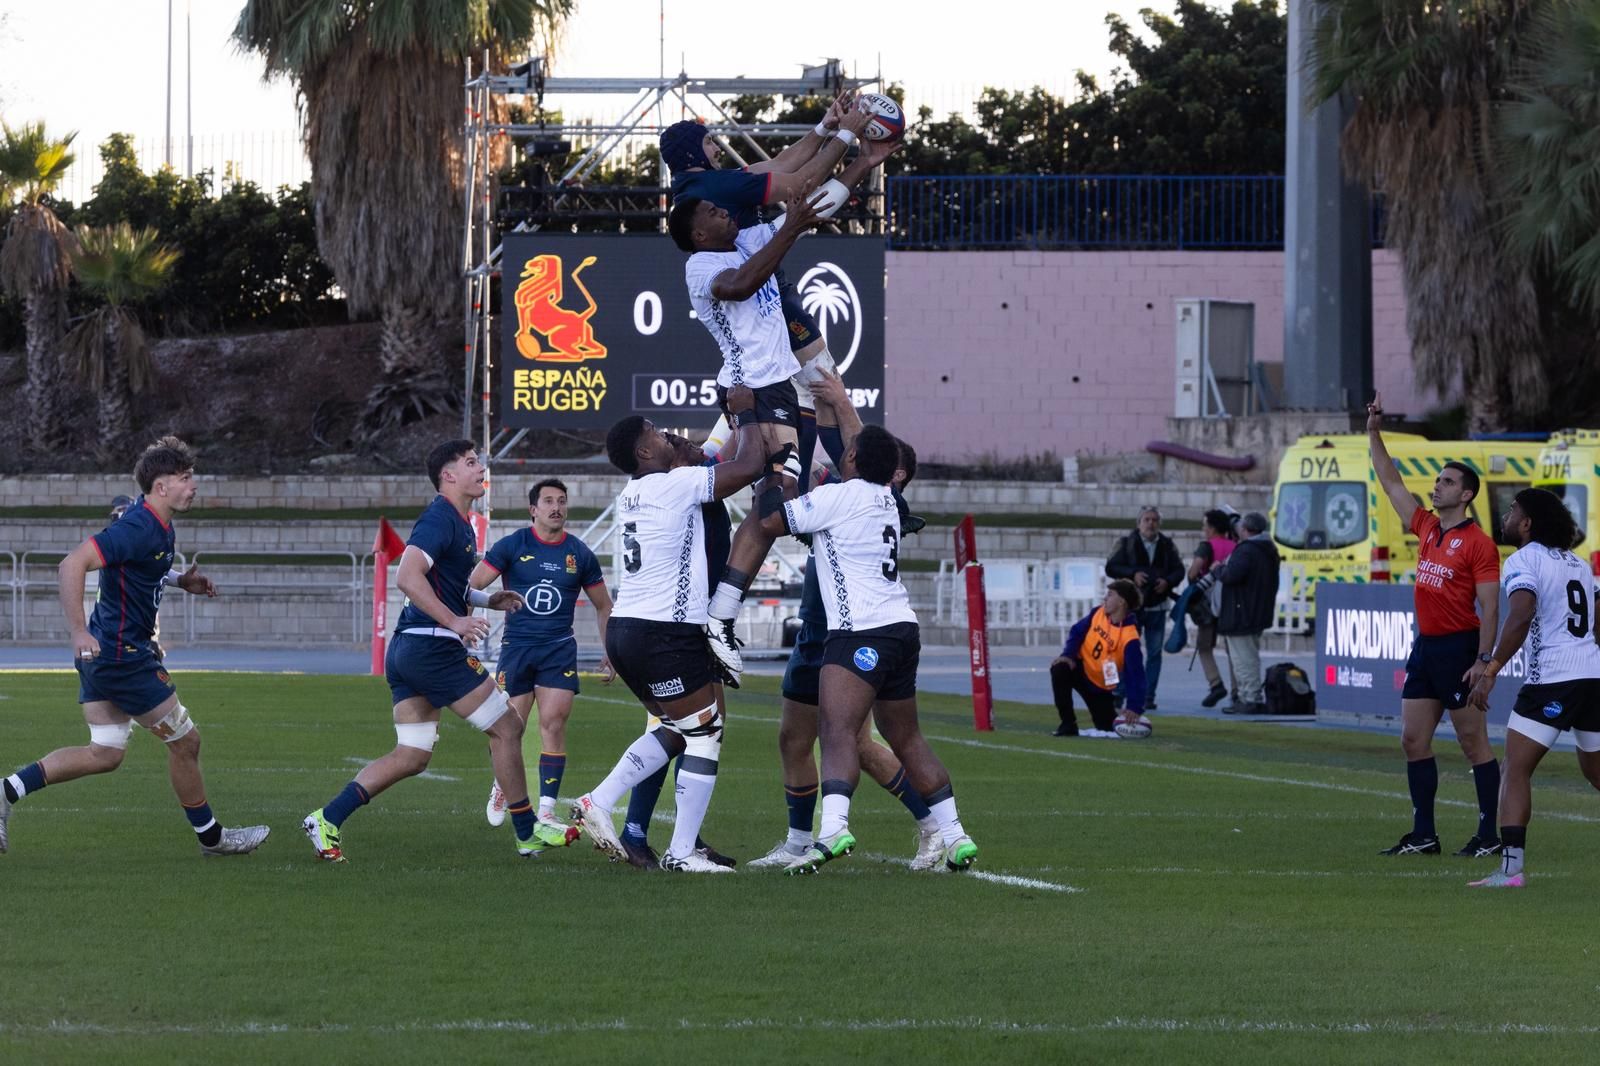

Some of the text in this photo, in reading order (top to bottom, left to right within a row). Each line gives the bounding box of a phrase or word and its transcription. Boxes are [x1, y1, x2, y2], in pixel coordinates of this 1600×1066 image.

[633, 291, 663, 335] 0
[514, 367, 607, 388] ESPAÑA
[514, 389, 607, 411] RUGBY
[651, 379, 718, 406] 00:5
[1300, 456, 1341, 478] DYA
[1542, 454, 1571, 479] DYA
[622, 521, 642, 574] 5
[882, 525, 898, 582] 3
[1566, 579, 1589, 639] 9
[1325, 608, 1414, 661] A WORLDWIDE
[648, 677, 682, 690] VISION
